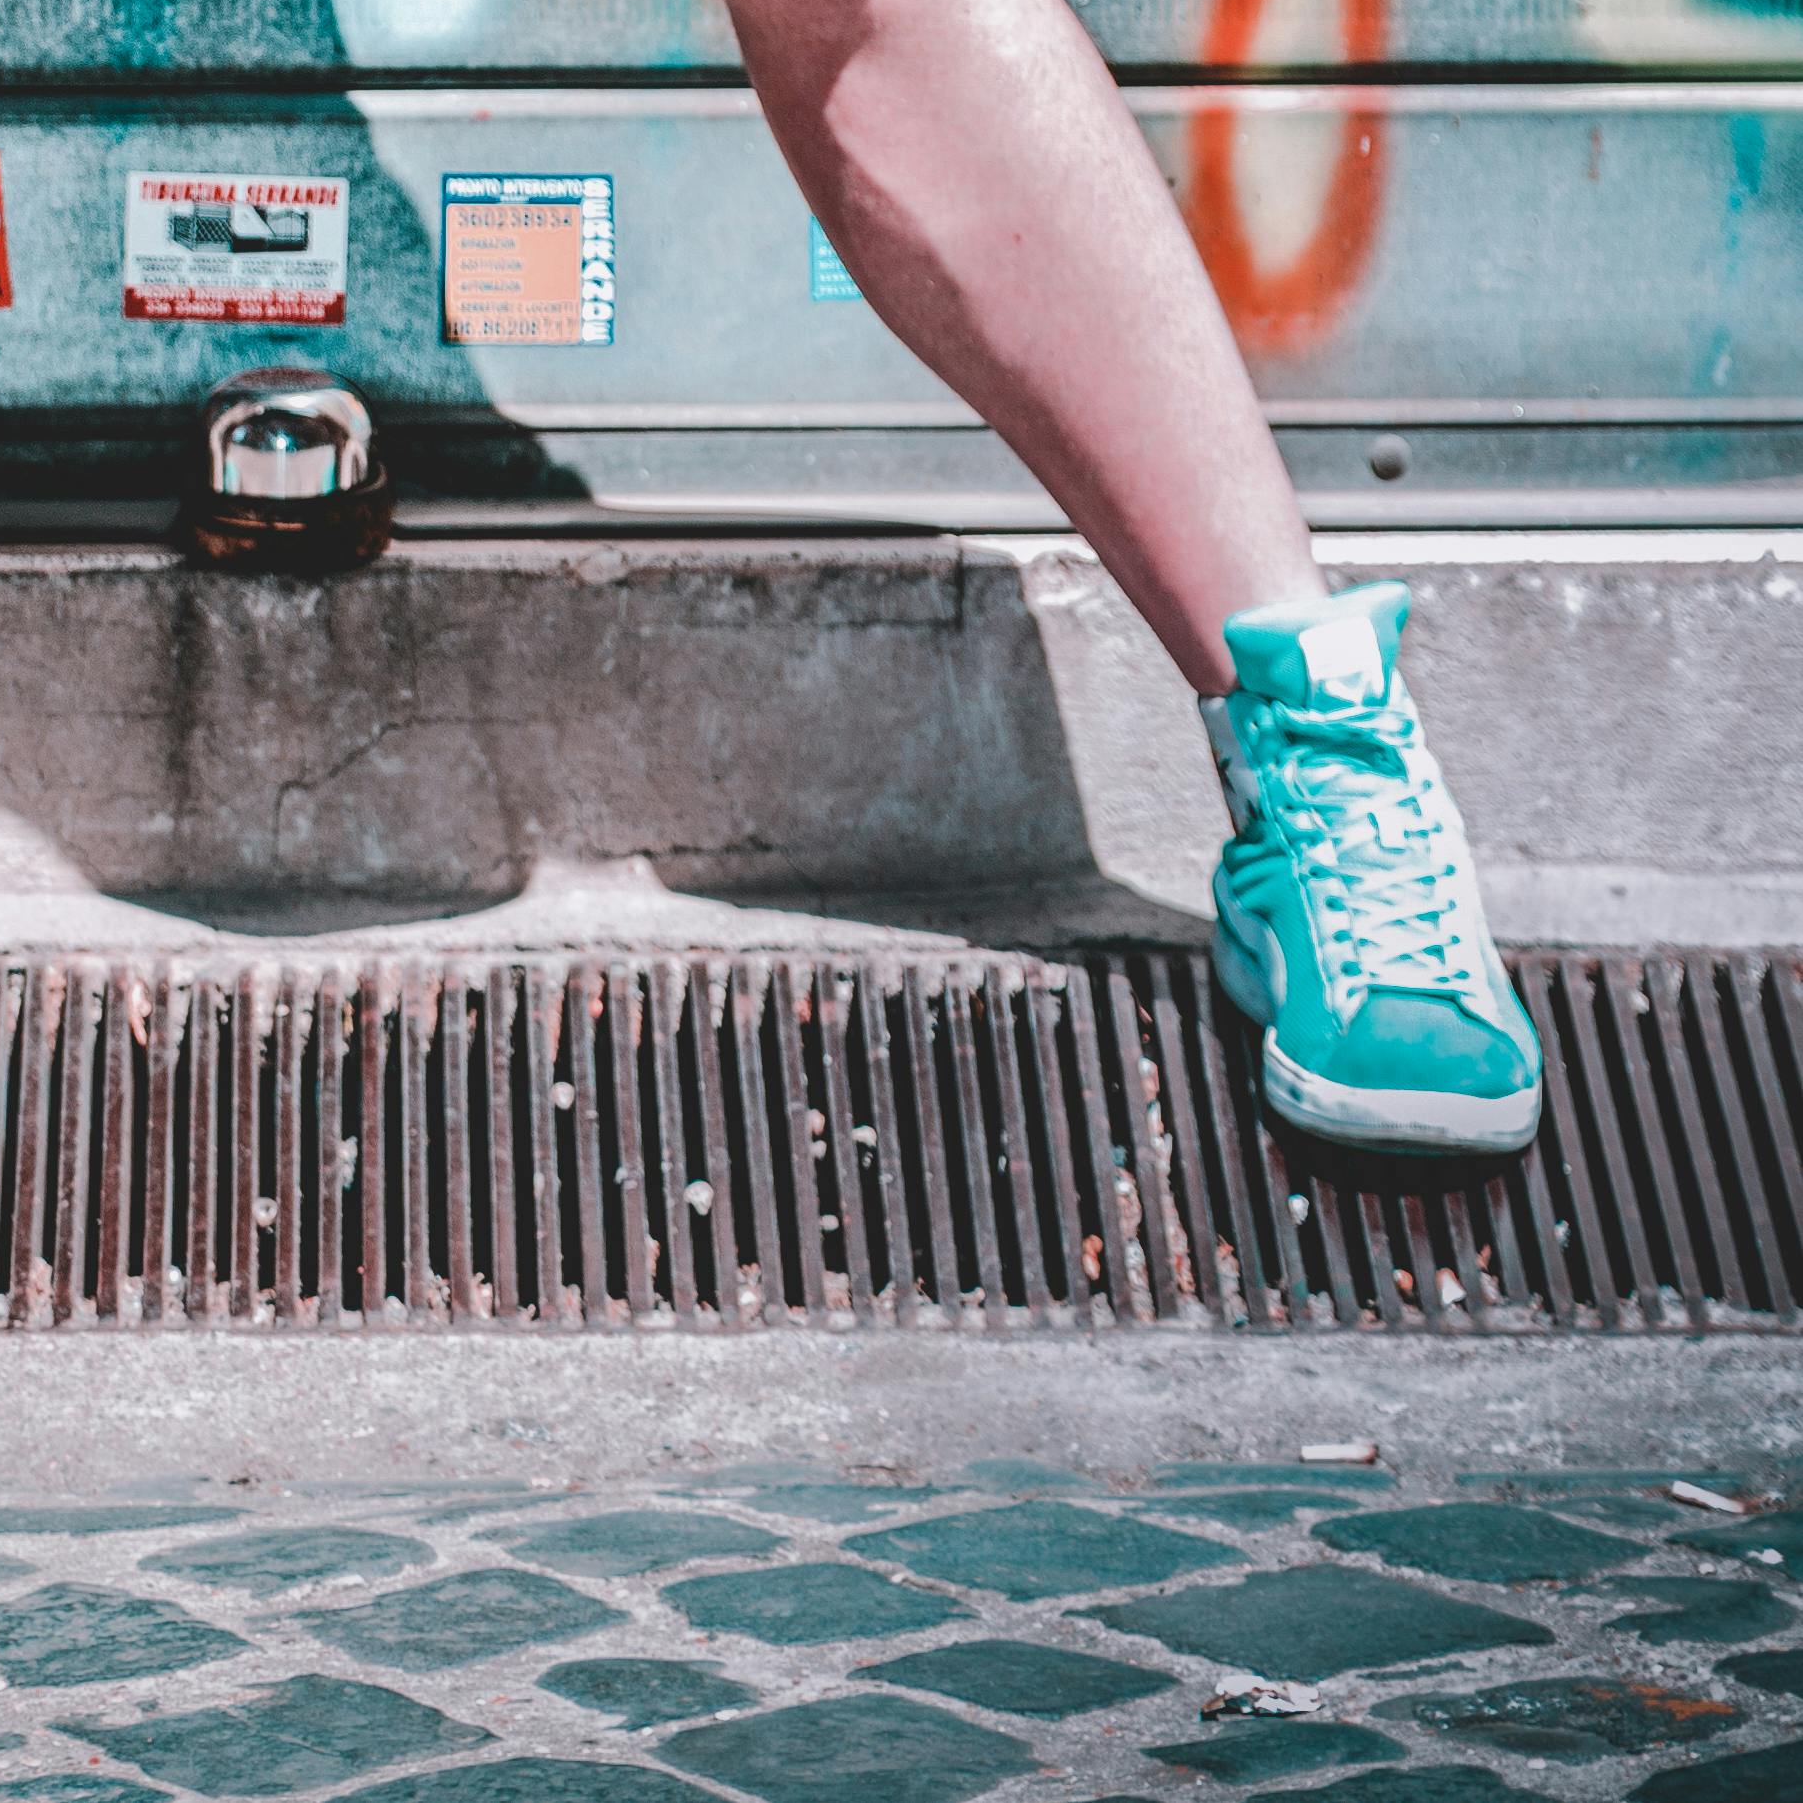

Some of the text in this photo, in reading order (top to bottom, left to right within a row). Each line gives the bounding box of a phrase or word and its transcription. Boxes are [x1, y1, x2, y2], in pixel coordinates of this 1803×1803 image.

[448, 178, 582, 197] PRONTO INTERVENTO
[582, 178, 614, 341] SERRANDE
